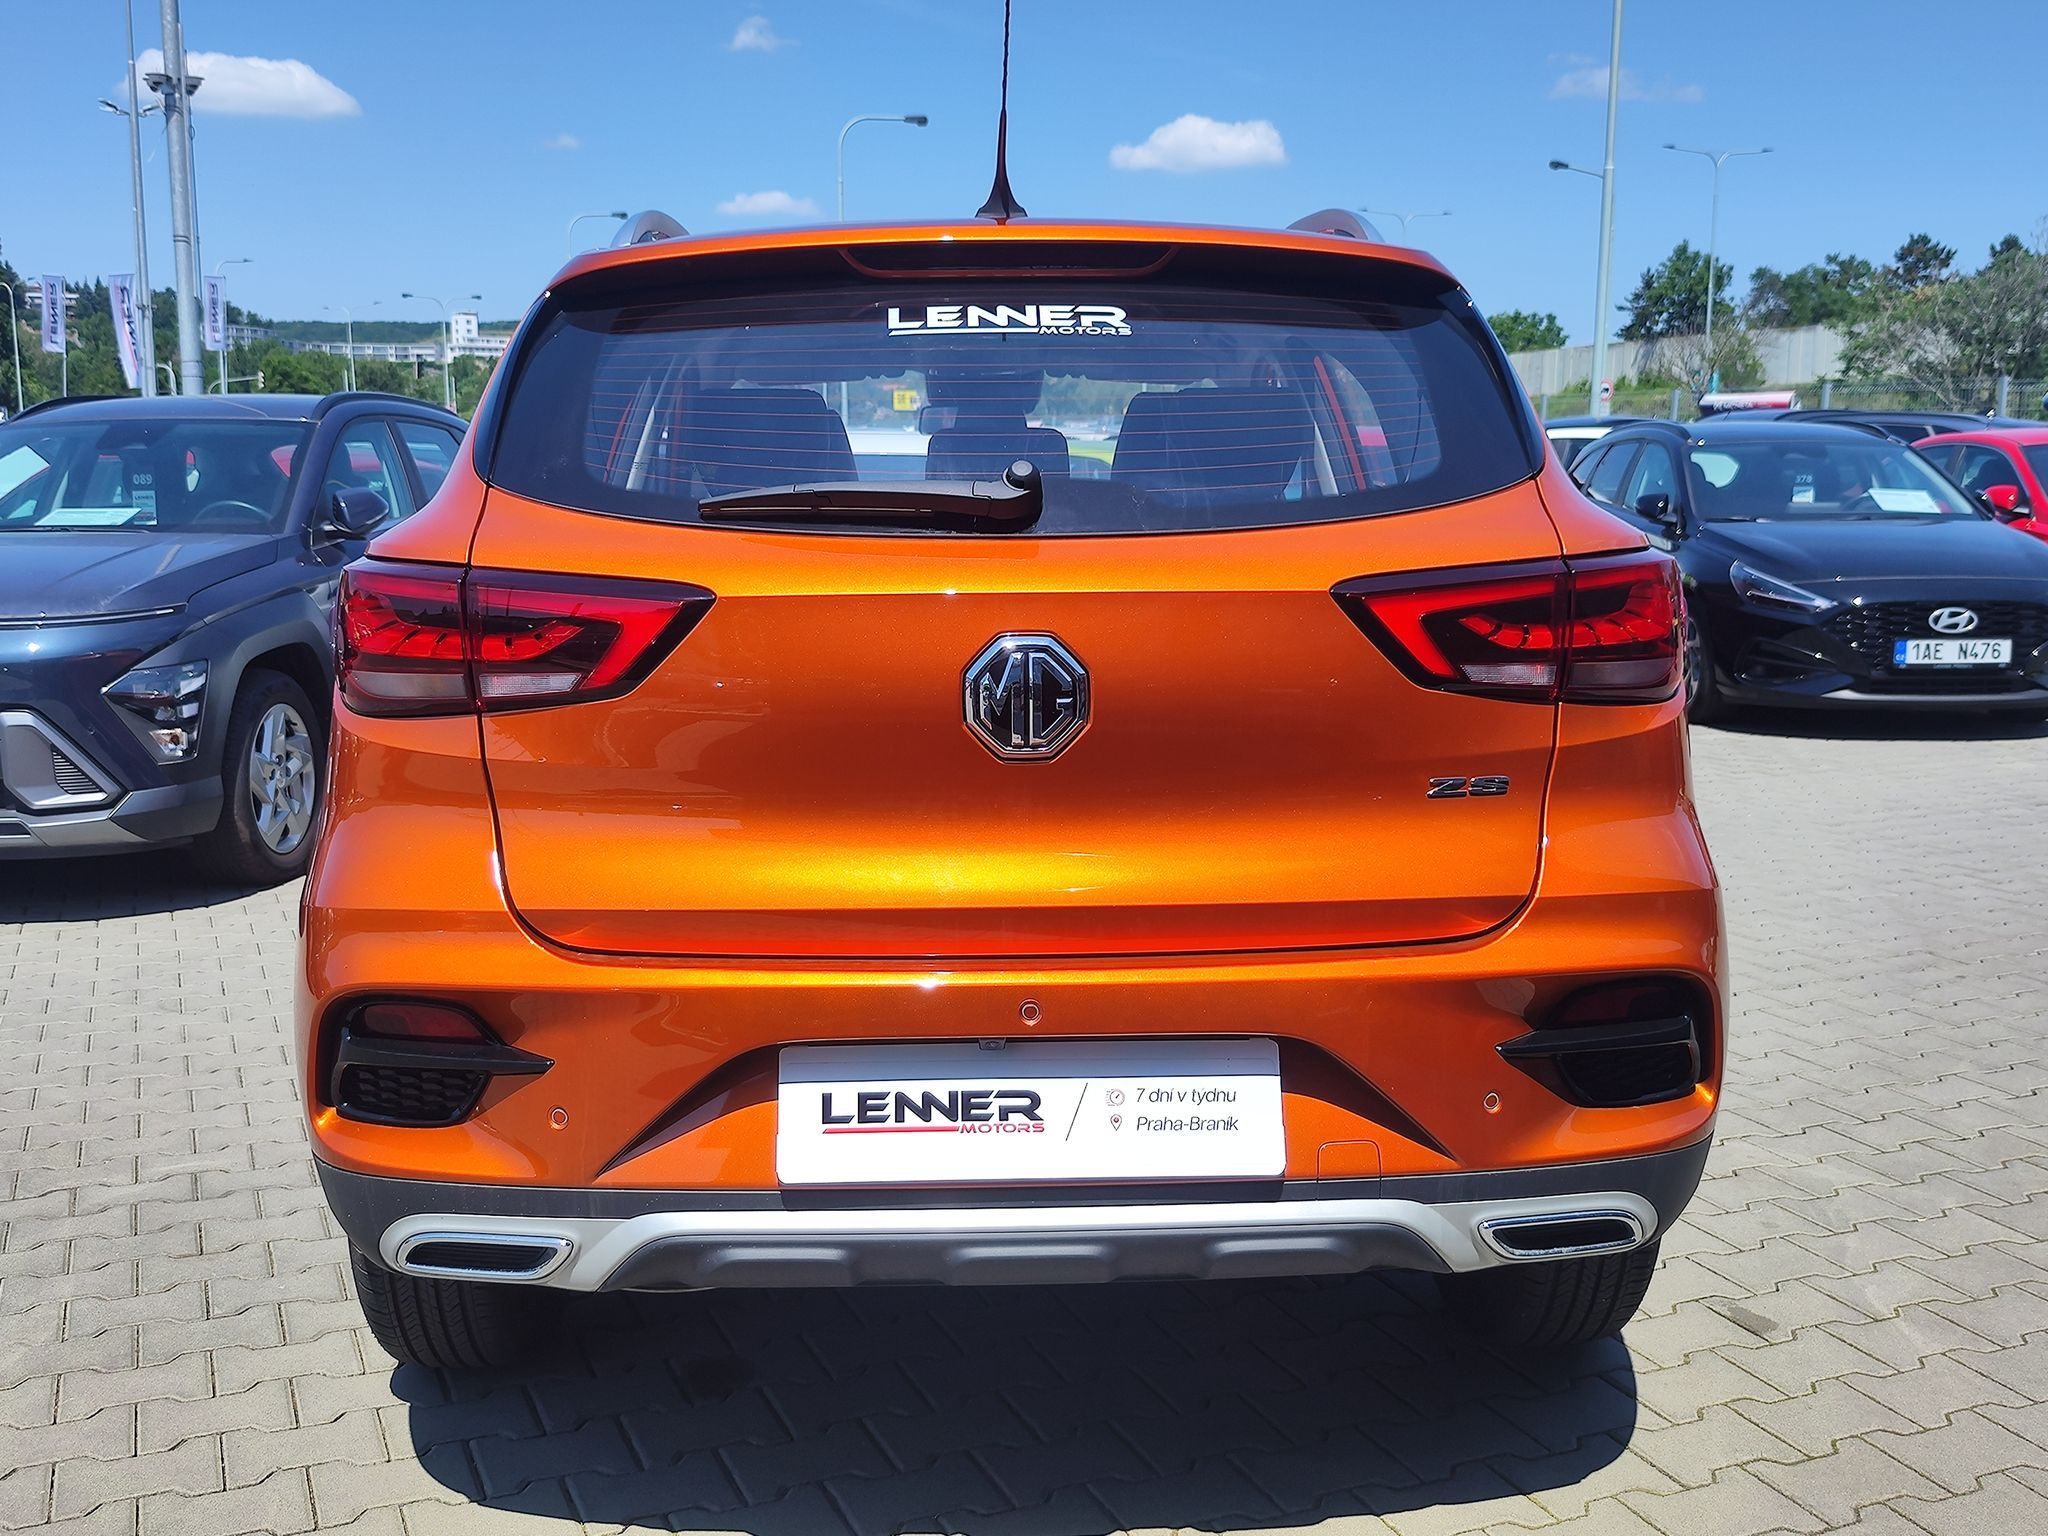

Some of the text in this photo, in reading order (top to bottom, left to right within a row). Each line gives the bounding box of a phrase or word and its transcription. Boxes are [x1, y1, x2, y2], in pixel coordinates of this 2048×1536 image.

[887, 304, 1132, 330] LENNER
[1038, 326, 1133, 336] MOTORS
[132, 473, 153, 485] 089
[1912, 643, 1943, 660] 1AE
[1957, 642, 2001, 660] N476
[979, 651, 1074, 747] MG
[1426, 775, 1510, 799] ZS
[1136, 1087, 1146, 1103] 7
[1148, 1087, 1175, 1103] dní
[1177, 1090, 1187, 1103] v
[821, 1089, 1045, 1124] LENNER
[959, 1122, 1045, 1134] MOTORS
